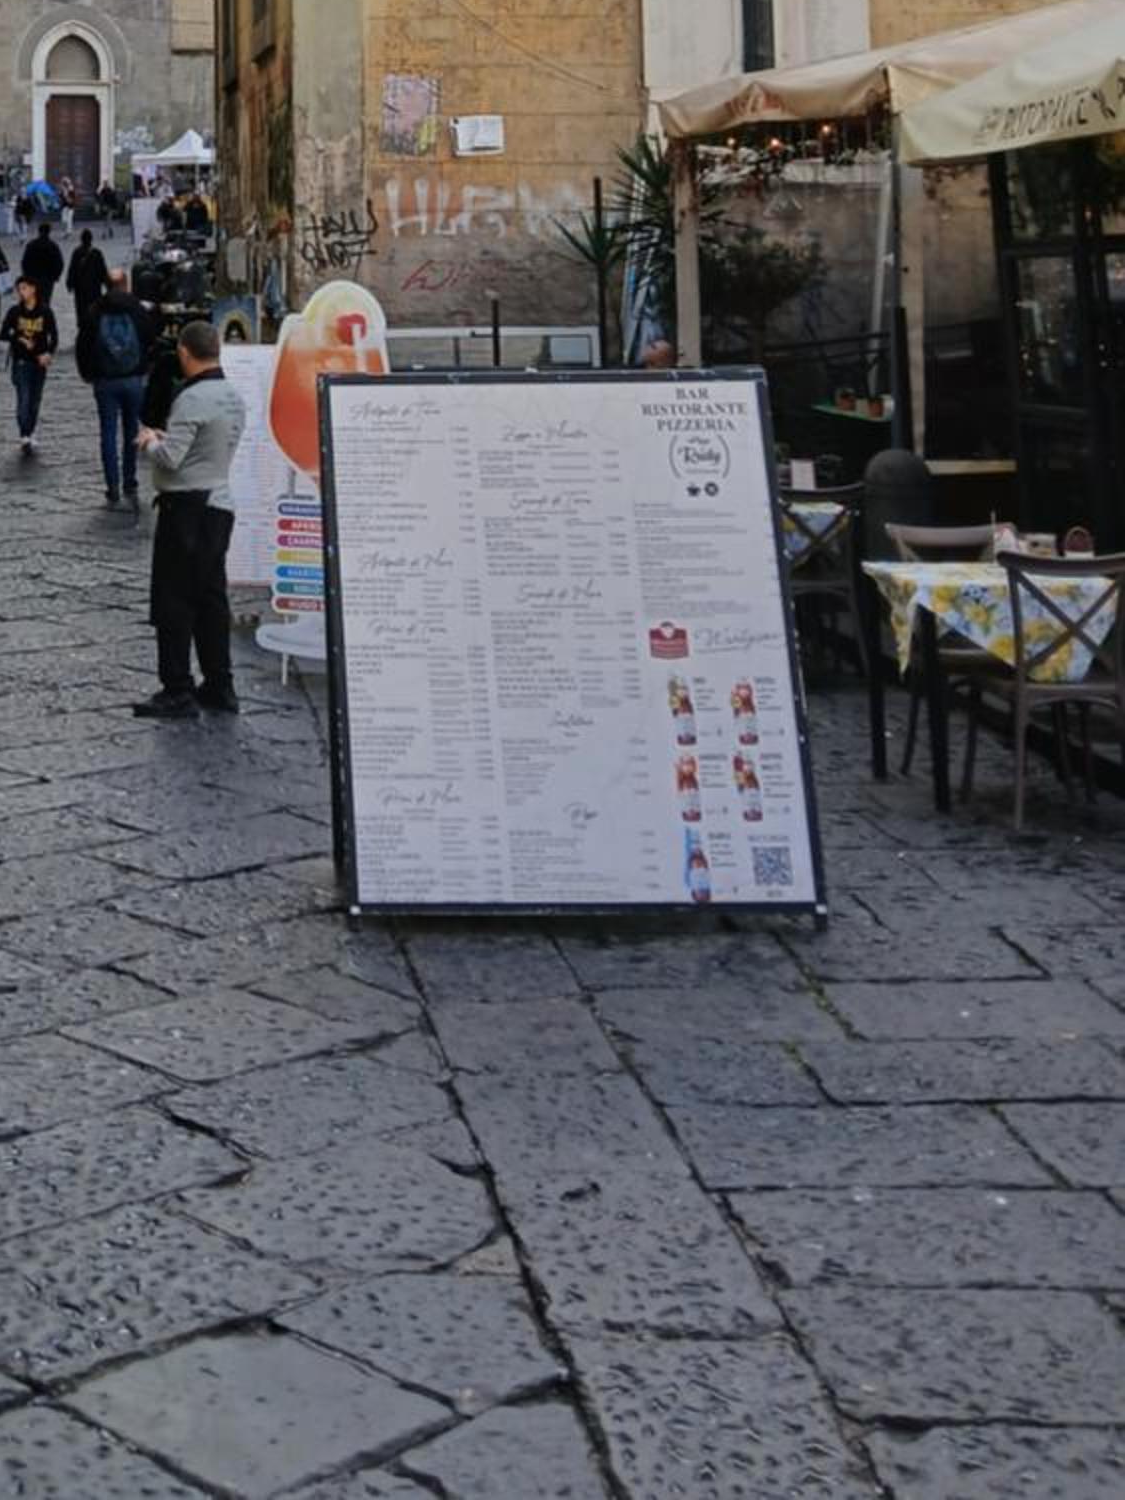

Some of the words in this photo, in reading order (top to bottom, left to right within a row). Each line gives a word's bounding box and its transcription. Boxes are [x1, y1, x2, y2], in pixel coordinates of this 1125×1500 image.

[676, 387, 710, 401] BAR
[641, 402, 747, 417] RISTORANTE
[656, 419, 736, 432] PIZZERIA
